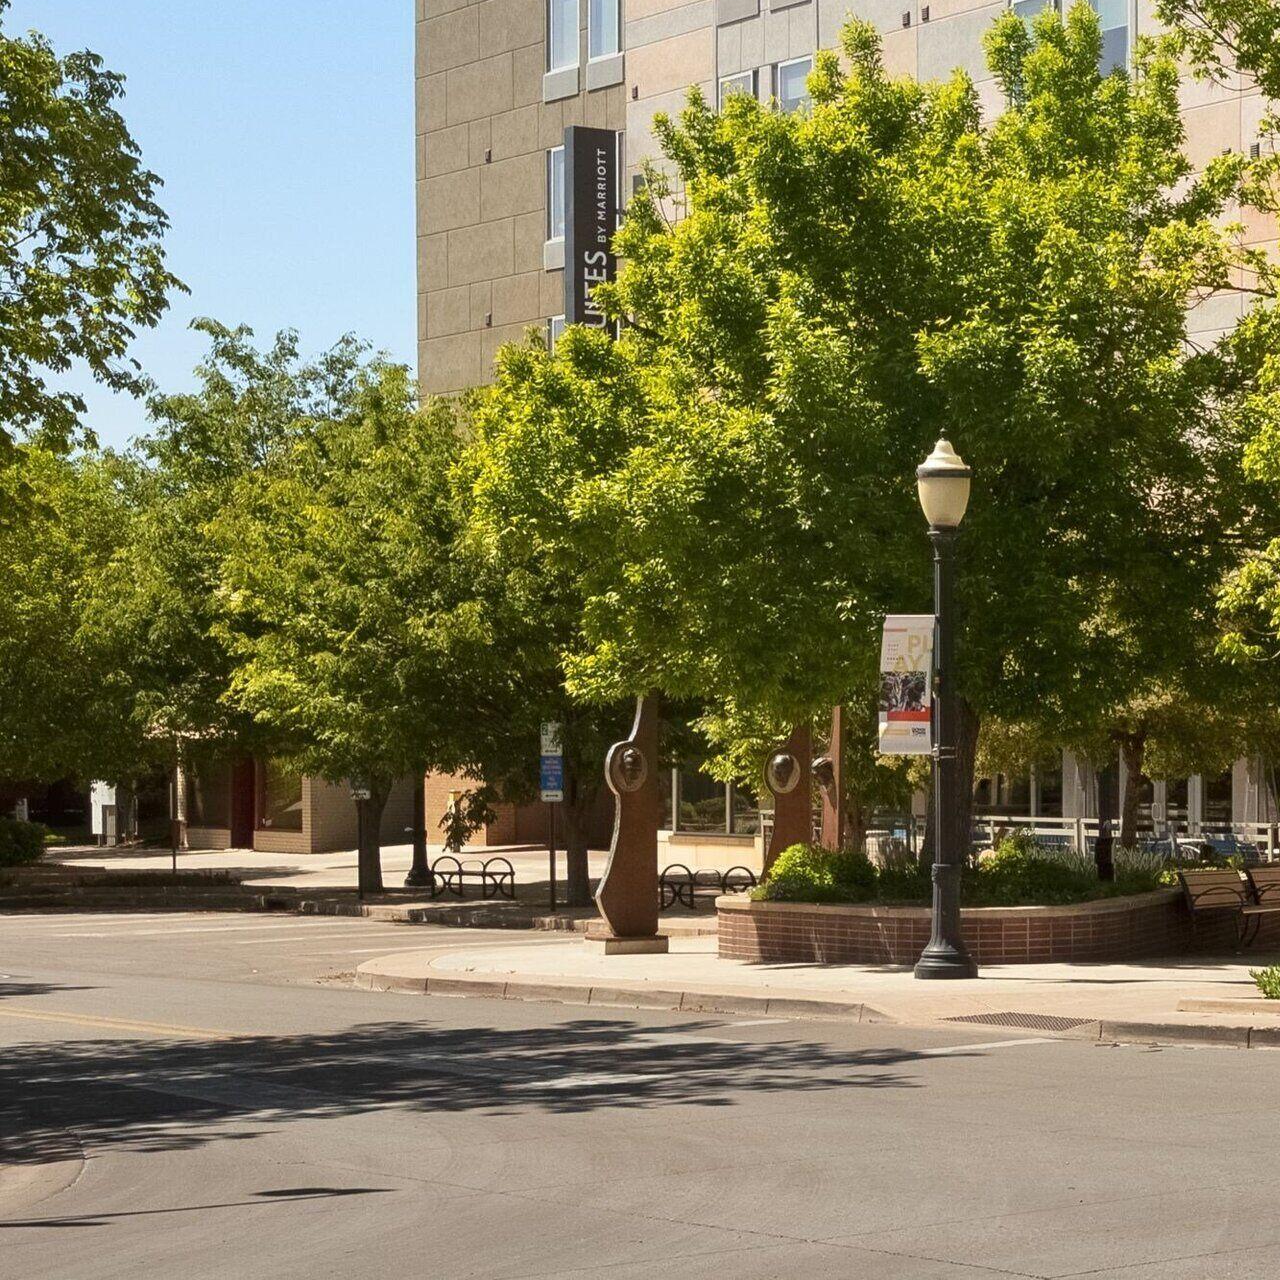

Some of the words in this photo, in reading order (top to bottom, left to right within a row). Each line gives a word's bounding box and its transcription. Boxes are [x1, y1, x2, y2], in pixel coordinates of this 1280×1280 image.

[597, 148, 606, 220] MARRIOTT
[597, 226, 606, 243] BY
[584, 251, 607, 329] UITES
